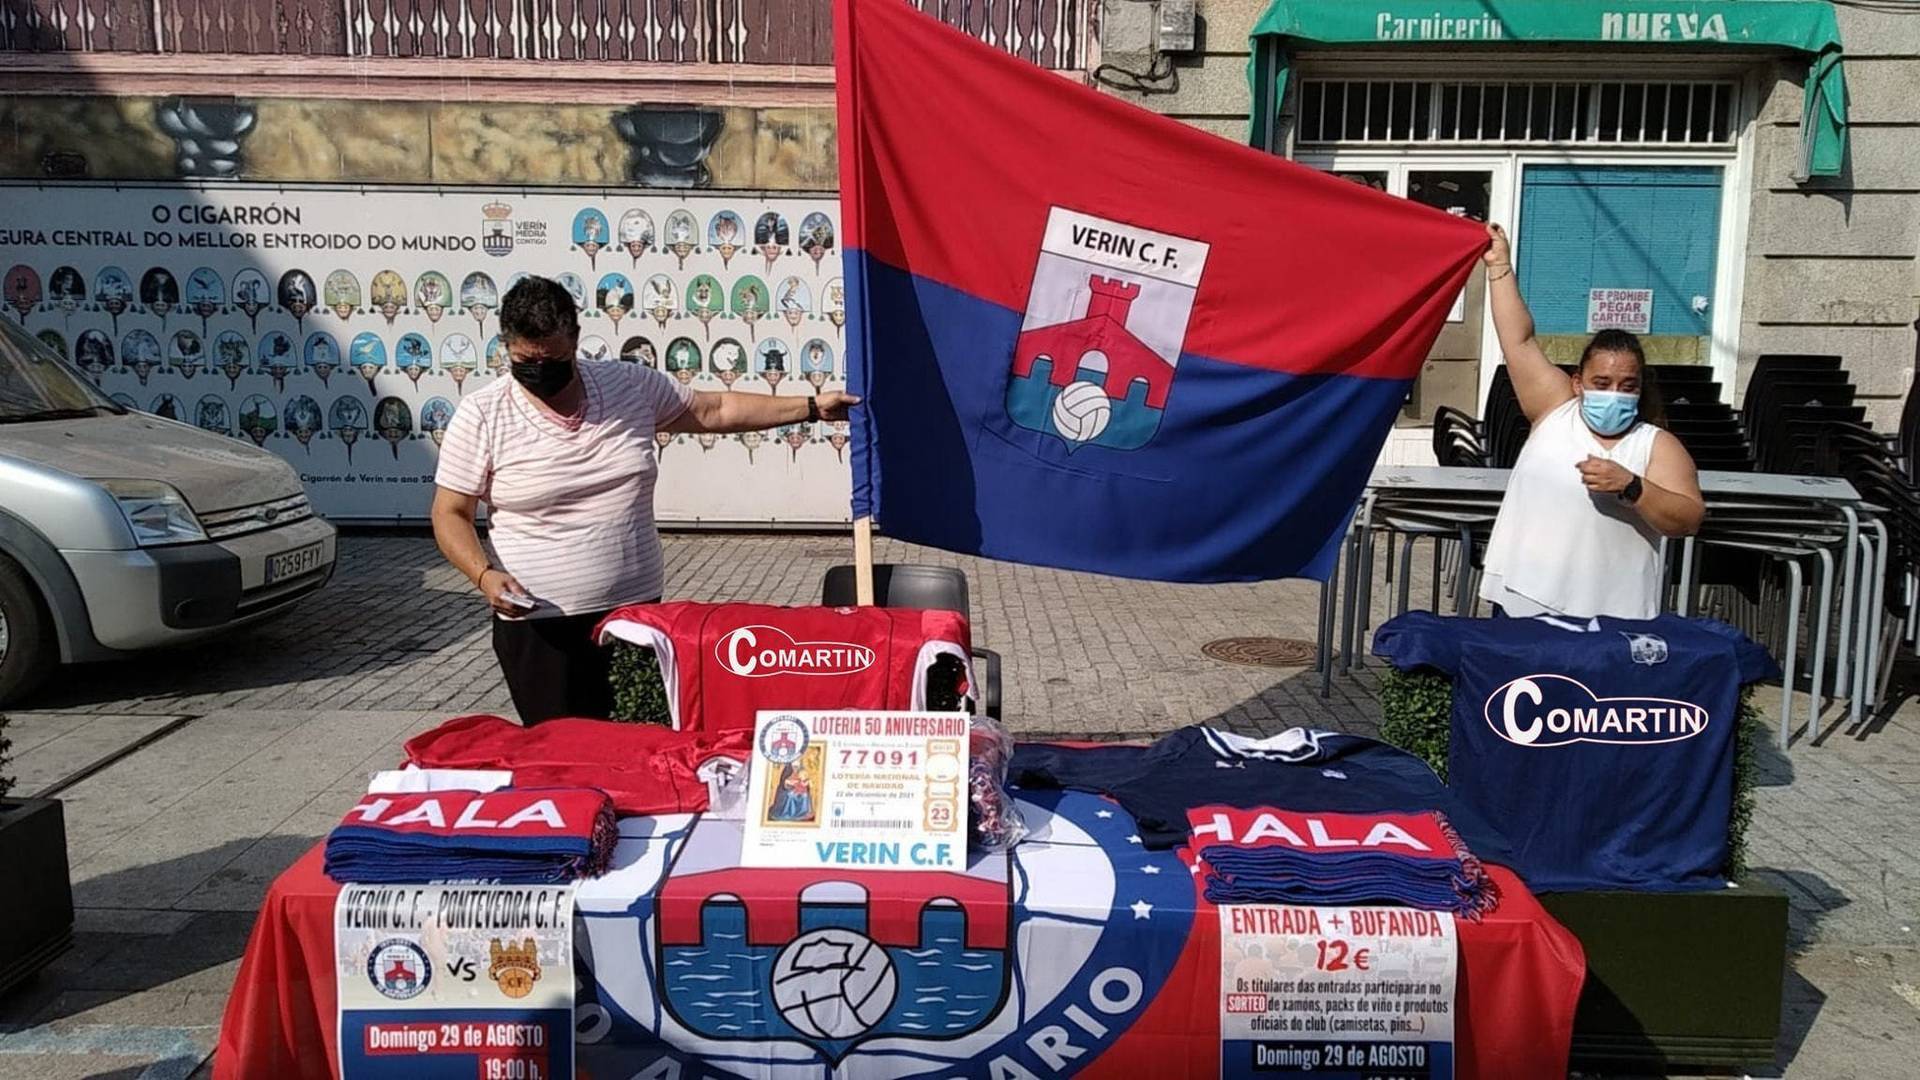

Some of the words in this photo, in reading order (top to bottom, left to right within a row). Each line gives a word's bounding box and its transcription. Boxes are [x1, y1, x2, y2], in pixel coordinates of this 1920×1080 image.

[152, 204, 171, 224] O
[178, 202, 301, 225] CIGARRÓN
[515, 219, 547, 230] VERÍN
[0, 229, 47, 245] GURA
[52, 230, 138, 247] CENTRAL
[144, 231, 172, 248] DO
[179, 232, 257, 248] MELLOR
[264, 233, 362, 250] ENTROIDO
[368, 235, 396, 250] DO
[402, 235, 476, 251] MUNDO
[1072, 224, 1136, 258] VERIN
[1139, 243, 1157, 264] C.
[1163, 248, 1178, 269] F.
[1592, 291, 1604, 301] SE
[1607, 291, 1649, 302] PROHIBE
[1599, 302, 1642, 312] PEGAR
[1592, 313, 1647, 323] CARTELES
[344, 473, 356, 483] de
[728, 627, 870, 675] COMARTIN
[1503, 679, 1701, 744] COMARTIN
[812, 716, 860, 735] LOTERIA
[865, 717, 881, 736] 50
[885, 718, 965, 737] ANIVERSARIO
[840, 750, 918, 765] 77091
[931, 808, 949, 820] 23
[816, 842, 900, 864] VERIN
[437, 889, 532, 928] PONTEVEDRA
[1231, 907, 1322, 935] ENTRADA
[1350, 910, 1443, 937] BUFANDA
[1251, 978, 1294, 993] titulares
[1297, 978, 1315, 993] das
[1317, 979, 1362, 993] entradas
[1430, 982, 1441, 994] no
[1228, 996, 1266, 1011] SORTEO
[1268, 998, 1280, 1012] de
[1325, 998, 1354, 1014] packs
[1357, 998, 1369, 1012] de
[1395, 1001, 1401, 1012] e
[1403, 999, 1448, 1015] produtos
[1251, 1016, 1288, 1032] oficiais
[1290, 1017, 1302, 1031] do
[1305, 1017, 1327, 1031] club
[370, 1026, 436, 1051] Domingo
[441, 1025, 460, 1047] 29
[463, 1025, 481, 1047] de
[486, 1025, 543, 1047] AGOSTO
[1257, 1045, 1320, 1070] Domingo
[1324, 1045, 1344, 1066] 29
[1348, 1045, 1365, 1066] de
[1368, 1045, 1425, 1067] AGOSTO
[485, 1059, 524, 1080] 19:00
